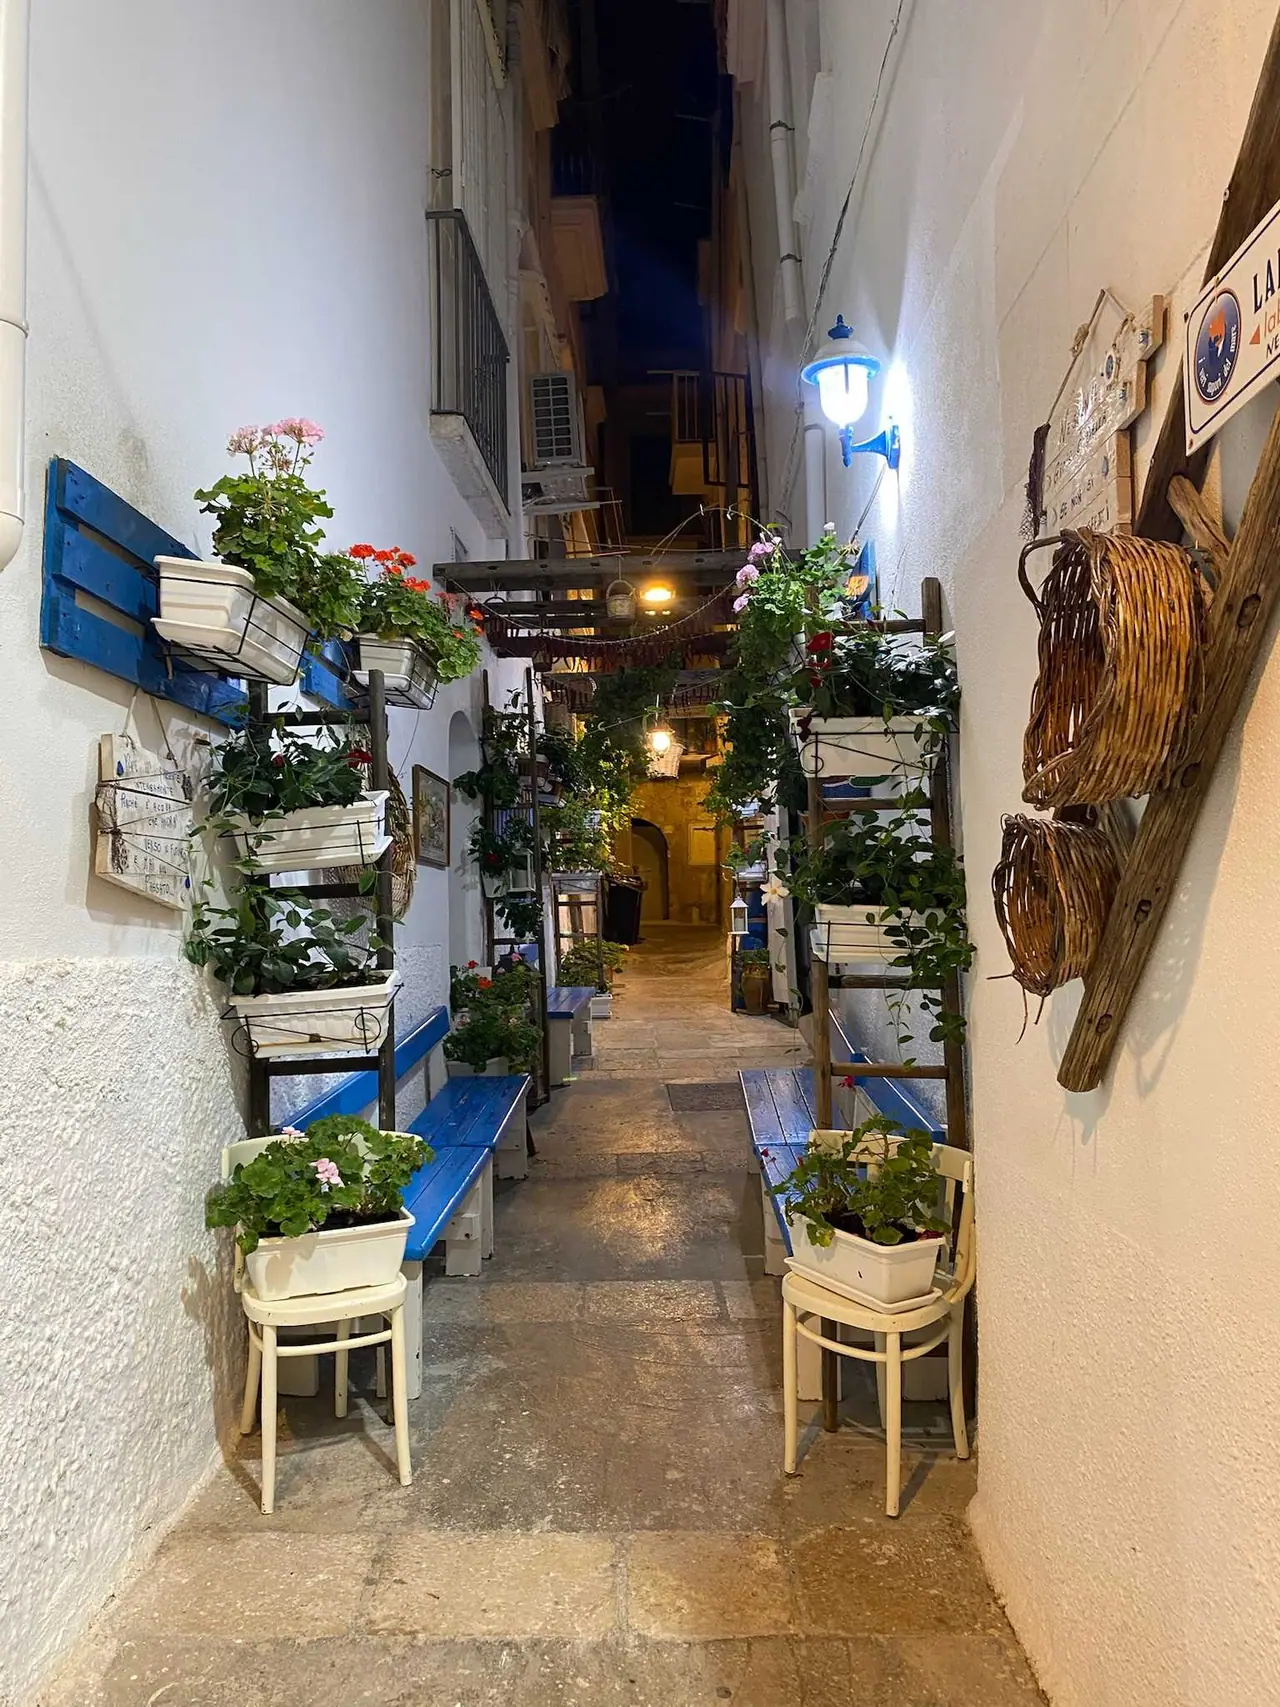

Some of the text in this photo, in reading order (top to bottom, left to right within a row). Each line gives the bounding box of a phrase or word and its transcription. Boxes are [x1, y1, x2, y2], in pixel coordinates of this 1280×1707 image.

[1253, 248, 1280, 314] LA
[1223, 357, 1232, 378] del
[1229, 324, 1237, 353] mare
